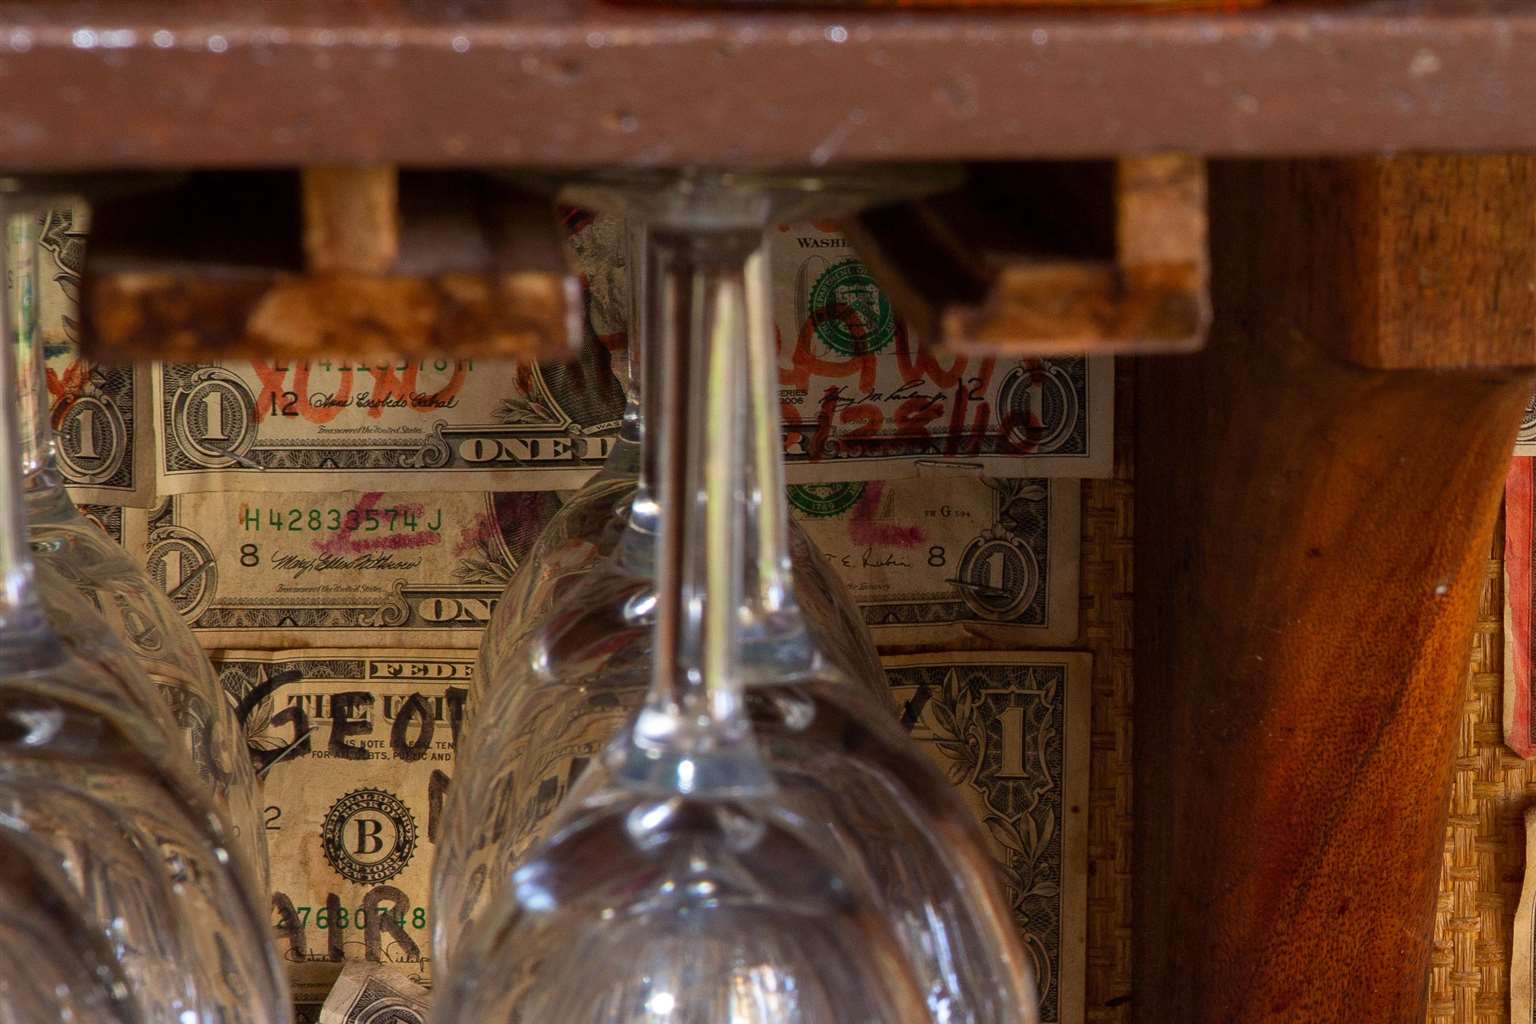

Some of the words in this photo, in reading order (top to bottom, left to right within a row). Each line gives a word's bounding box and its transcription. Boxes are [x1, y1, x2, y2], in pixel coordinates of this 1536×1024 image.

[796, 236, 850, 249] WASHI
[270, 391, 299, 417] 12
[458, 437, 576, 463] ONE
[239, 543, 260, 568] 8
[927, 545, 946, 568] 8
[418, 598, 493, 622] ON
[353, 818, 384, 855] B
